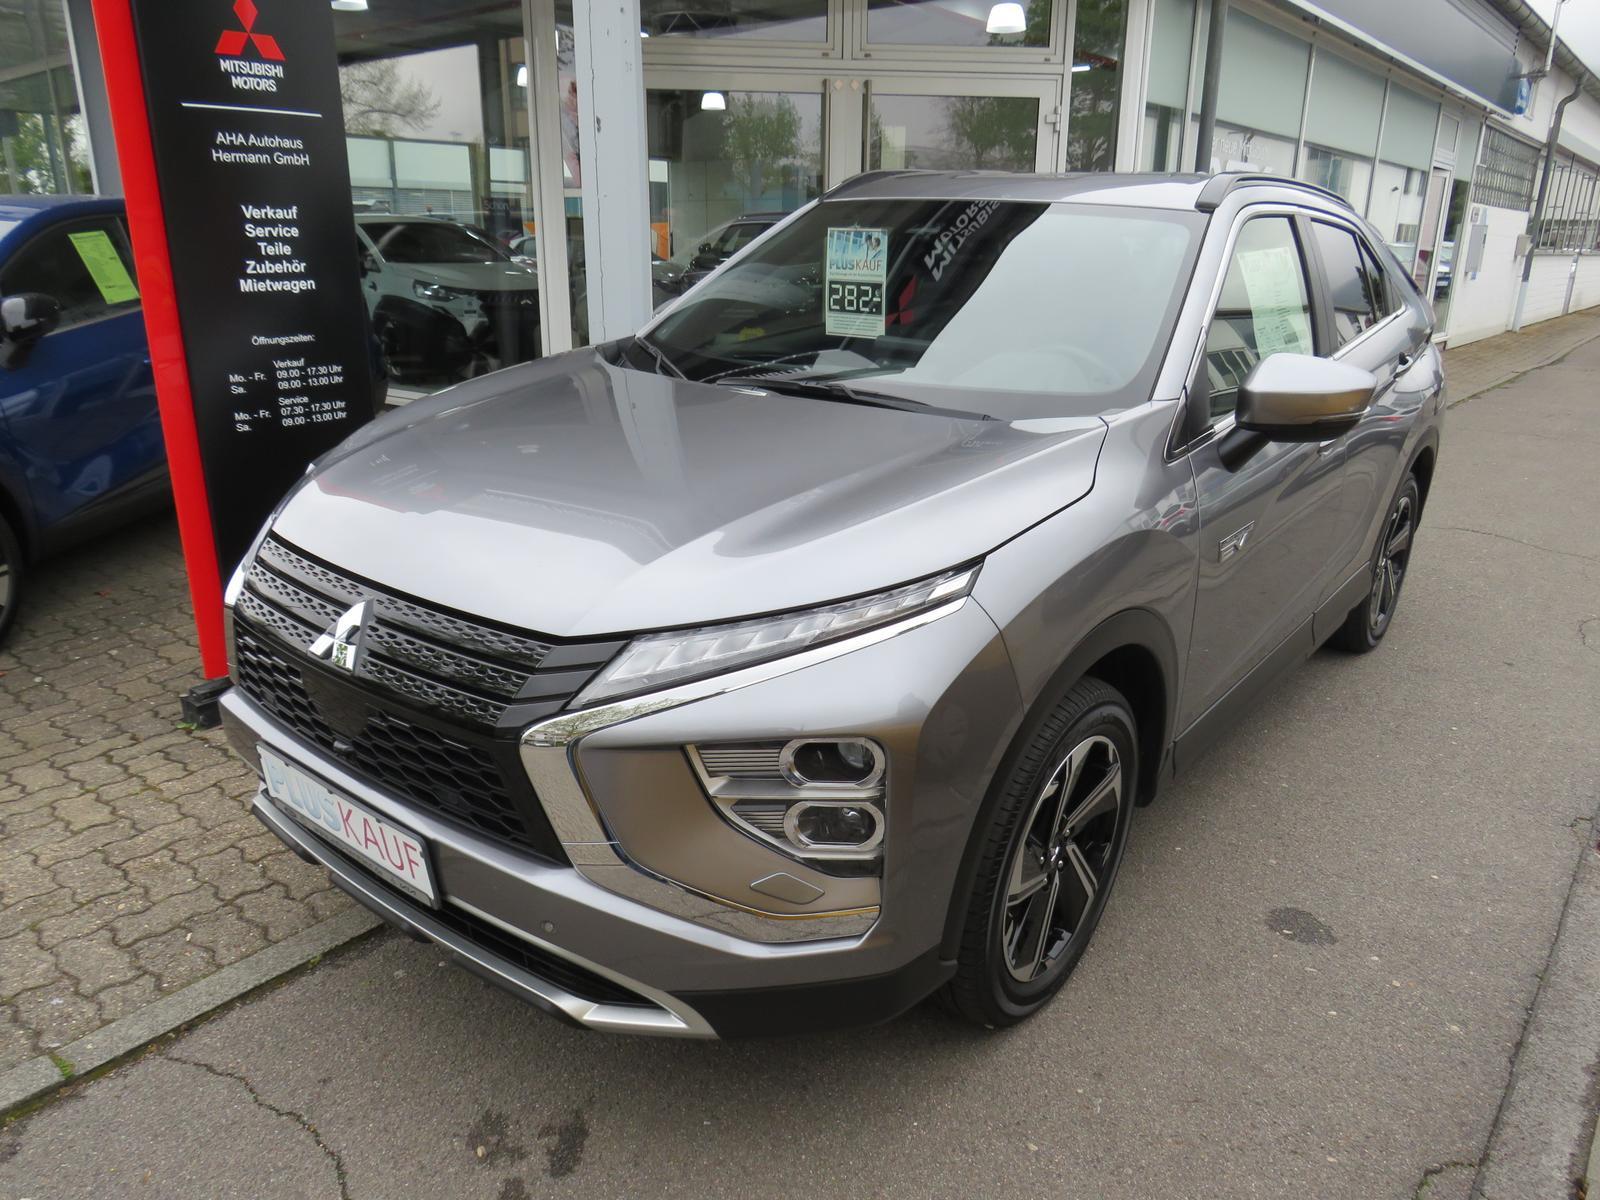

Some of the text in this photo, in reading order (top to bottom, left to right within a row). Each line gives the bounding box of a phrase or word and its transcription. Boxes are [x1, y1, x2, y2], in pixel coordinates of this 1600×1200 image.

[219, 59, 284, 78] MITSUBISHI
[231, 76, 277, 92] MOTORS
[216, 132, 303, 150] AHA Autohaus
[211, 149, 310, 166] Hermann GmbH
[240, 204, 298, 220] Verkauf
[244, 223, 300, 238] Service
[257, 242, 292, 256] Teile
[245, 259, 306, 274] Zubehör
[239, 278, 316, 294] Mietwagen
[273, 358, 305, 369] Verkauf
[229, 374, 247, 383] Mo.
[254, 372, 267, 381] Fr.
[276, 369, 300, 379] 09.00
[307, 366, 328, 376] 17.30
[328, 365, 342, 373] Uhr
[230, 385, 247, 394] Sa.
[277, 380, 301, 390] 09.00
[308, 377, 329, 387] 13.00
[330, 376, 343, 384] Uhr
[278, 396, 309, 406] Service
[234, 412, 252, 421] Mo.
[259, 410, 272, 419] Fr.
[280, 406, 304, 416] 07.30
[311, 403, 331, 412] 17.30
[332, 401, 346, 409] Uhr
[235, 424, 252, 432] Sa.
[282, 417, 305, 427] 09.00
[312, 413, 333, 423] 13.00
[333, 411, 347, 420] Uhr
